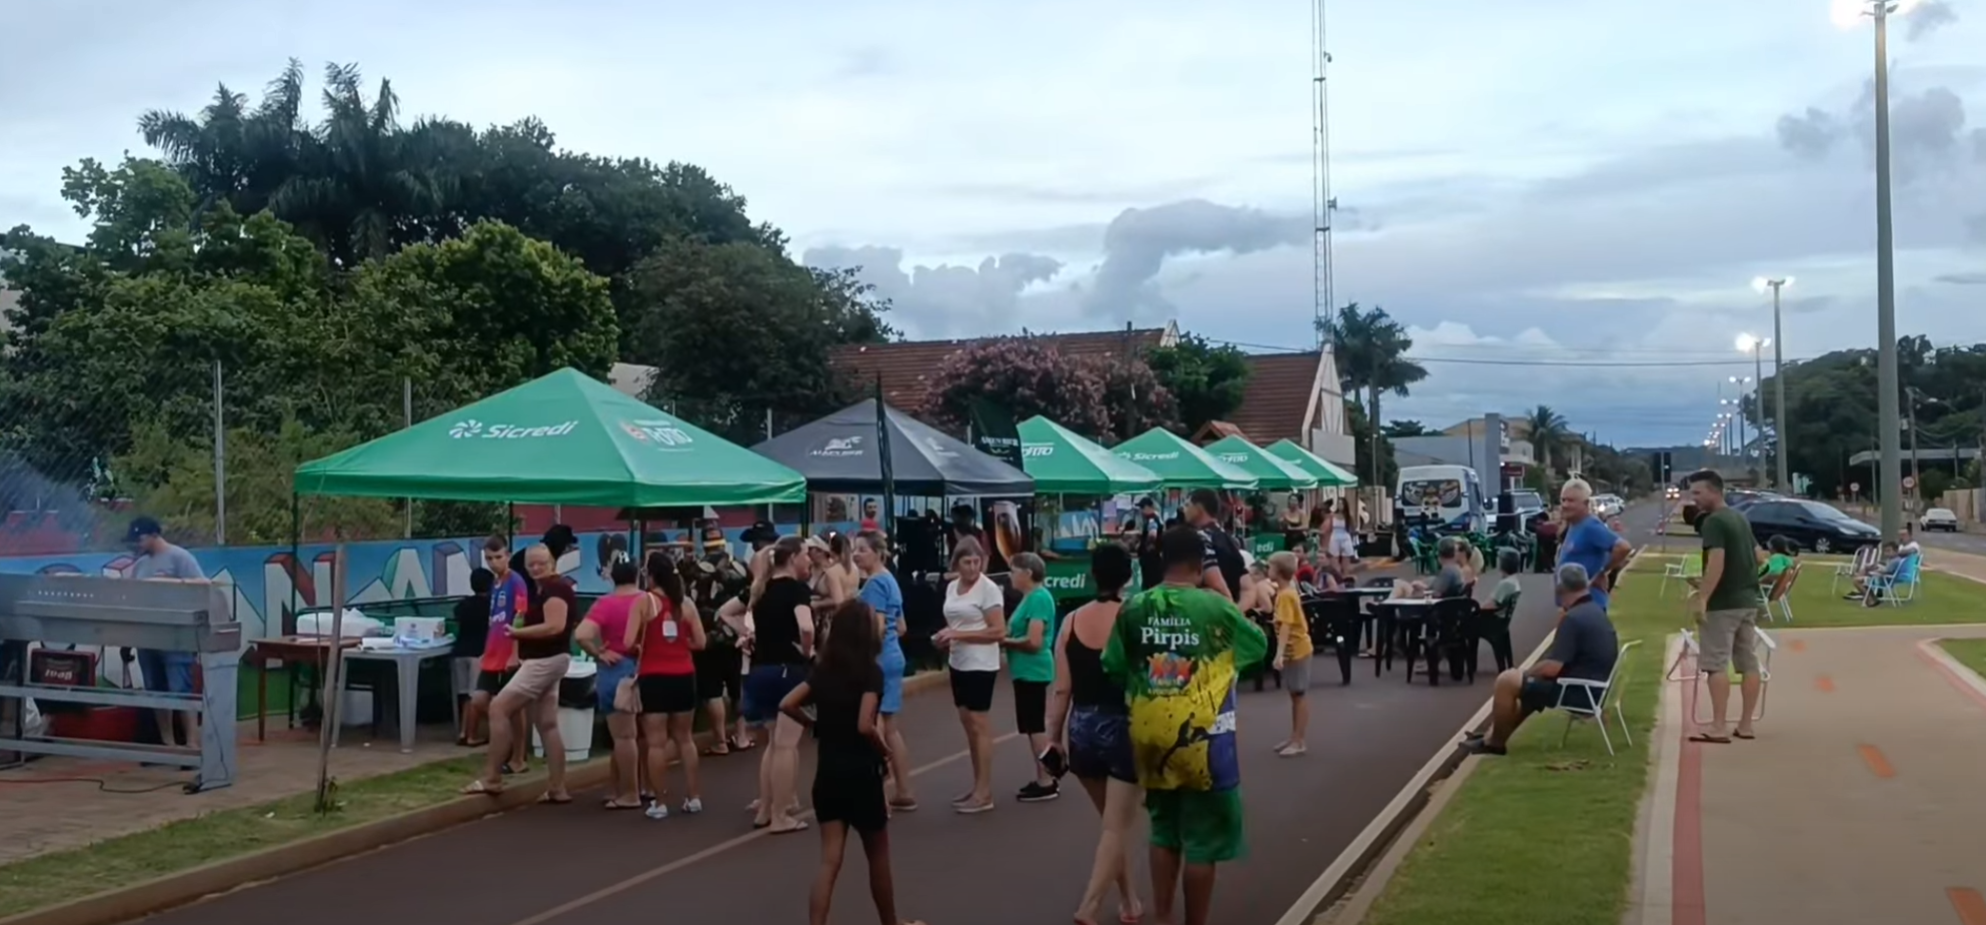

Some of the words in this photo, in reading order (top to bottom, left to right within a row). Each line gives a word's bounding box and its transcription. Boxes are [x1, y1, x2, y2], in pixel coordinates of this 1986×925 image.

[481, 420, 579, 439] Sicredi
[1132, 450, 1180, 461] Sicredi
[1256, 541, 1275, 553] edi
[1043, 573, 1086, 589] credi
[1140, 626, 1200, 651] Pirpis
